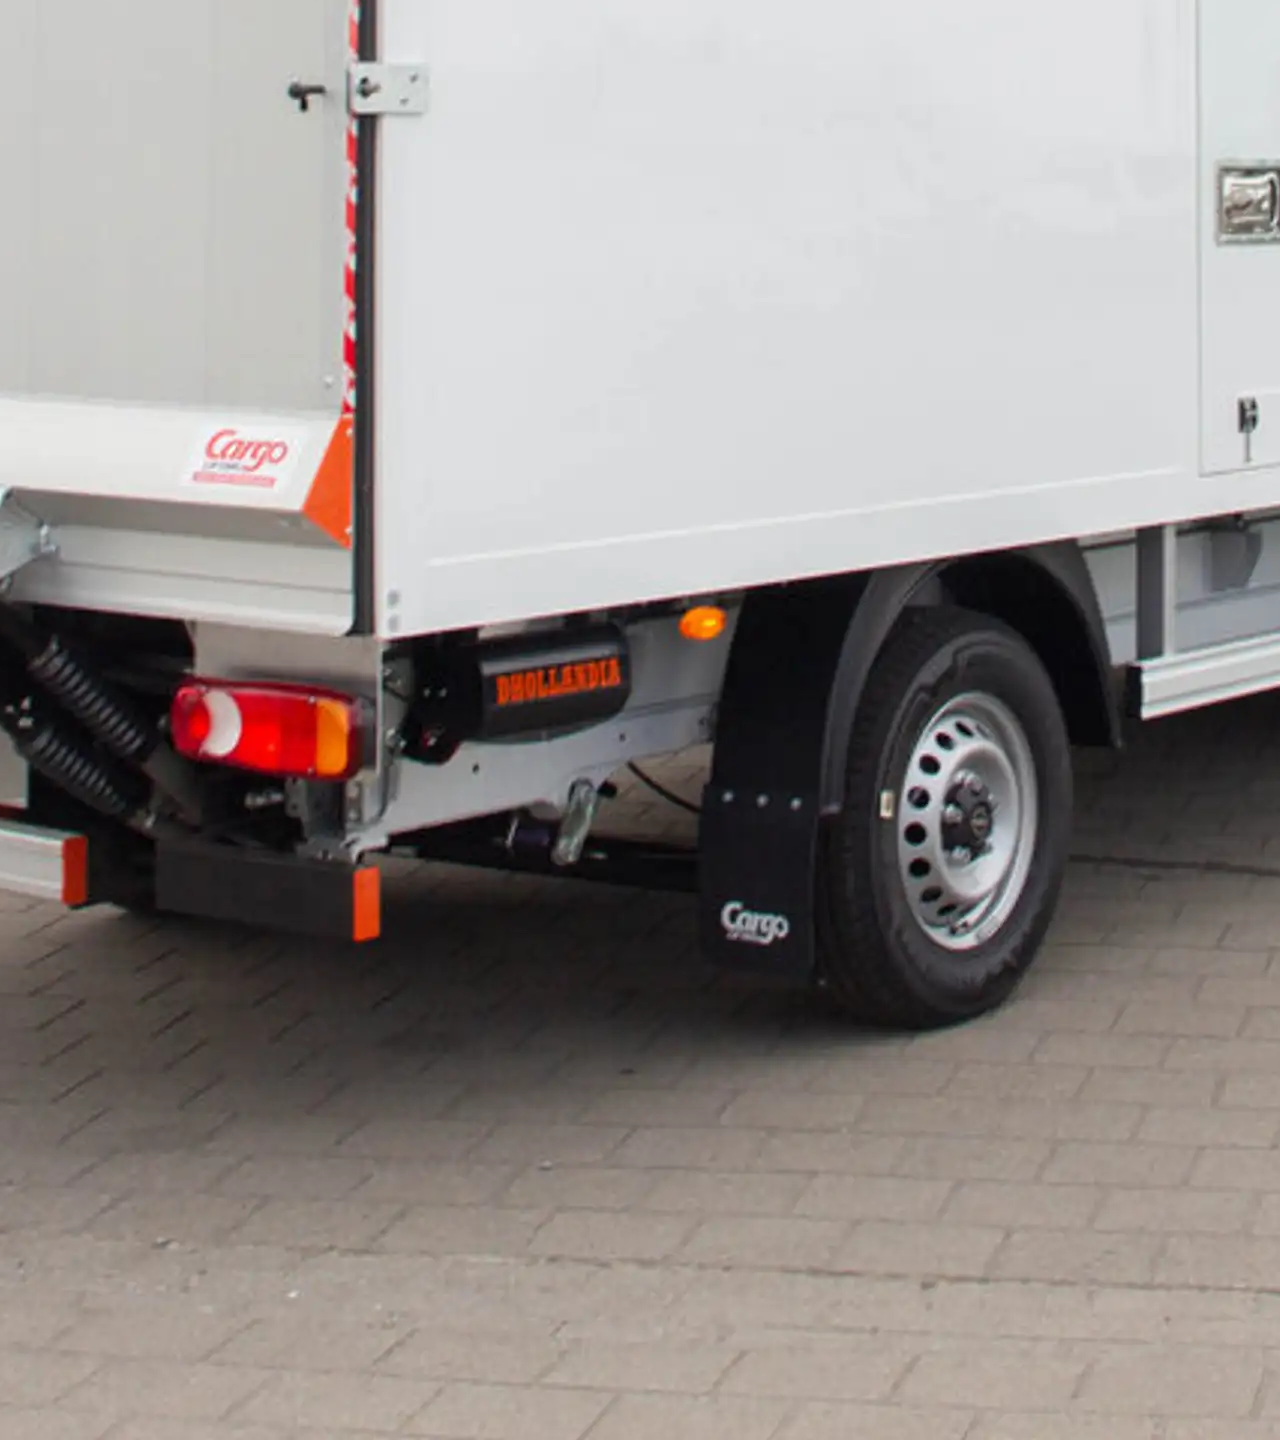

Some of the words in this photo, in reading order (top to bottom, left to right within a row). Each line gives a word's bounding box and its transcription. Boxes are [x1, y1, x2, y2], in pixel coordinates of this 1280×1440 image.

[205, 428, 288, 472] Cargo
[496, 656, 621, 706] DHOLLANDIA
[721, 900, 790, 945] Cargo
